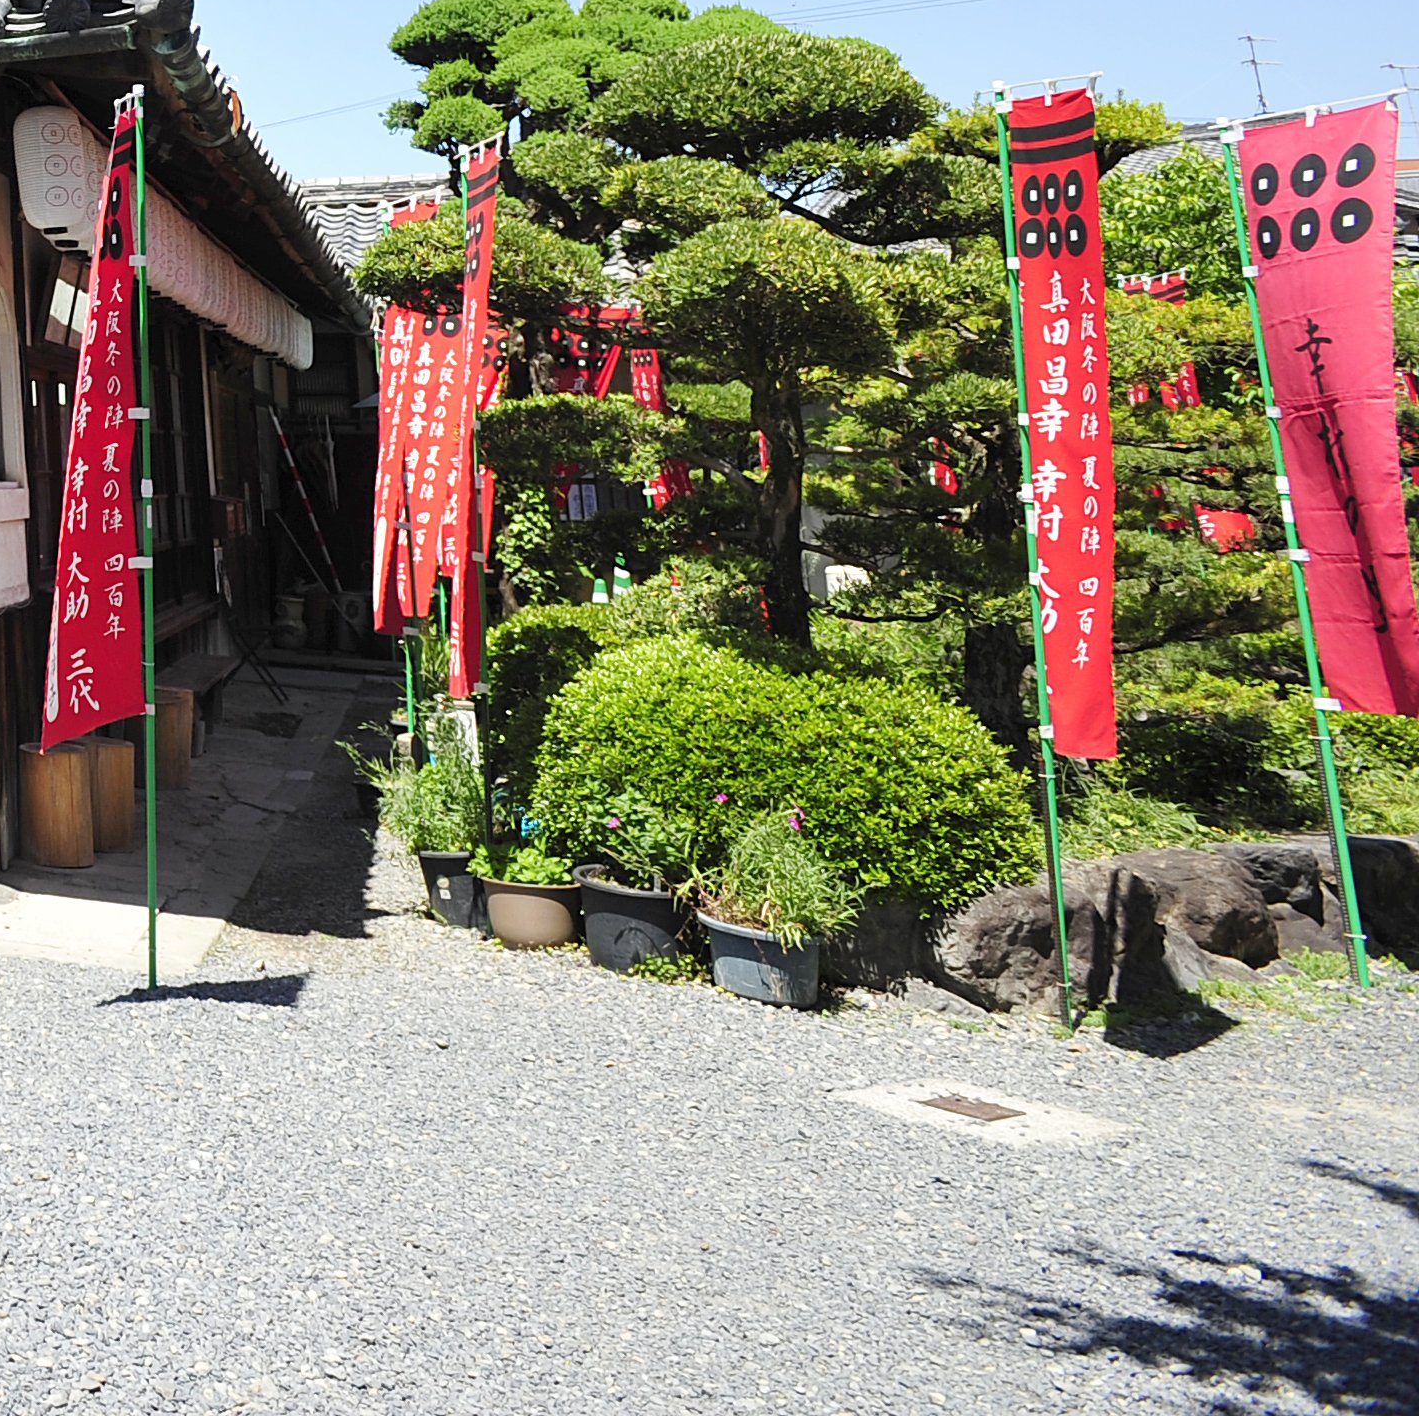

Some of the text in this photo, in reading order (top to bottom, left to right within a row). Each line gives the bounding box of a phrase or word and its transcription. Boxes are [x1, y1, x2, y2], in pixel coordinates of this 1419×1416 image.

[407, 342, 434, 439] 真田昌幸
[1032, 271, 1069, 442] 真田昌幸
[67, 457, 89, 533] 幸村
[102, 279, 125, 639] 大阪冬の陣 夏の陣 四百年
[413, 349, 457, 564] 大阪冬の陣 夏の陣 四百年
[1072, 278, 1100, 669] 大阪冬の陣 夏の陣 四百年
[64, 552, 89, 623] 大助
[67, 648, 99, 713] 三代
